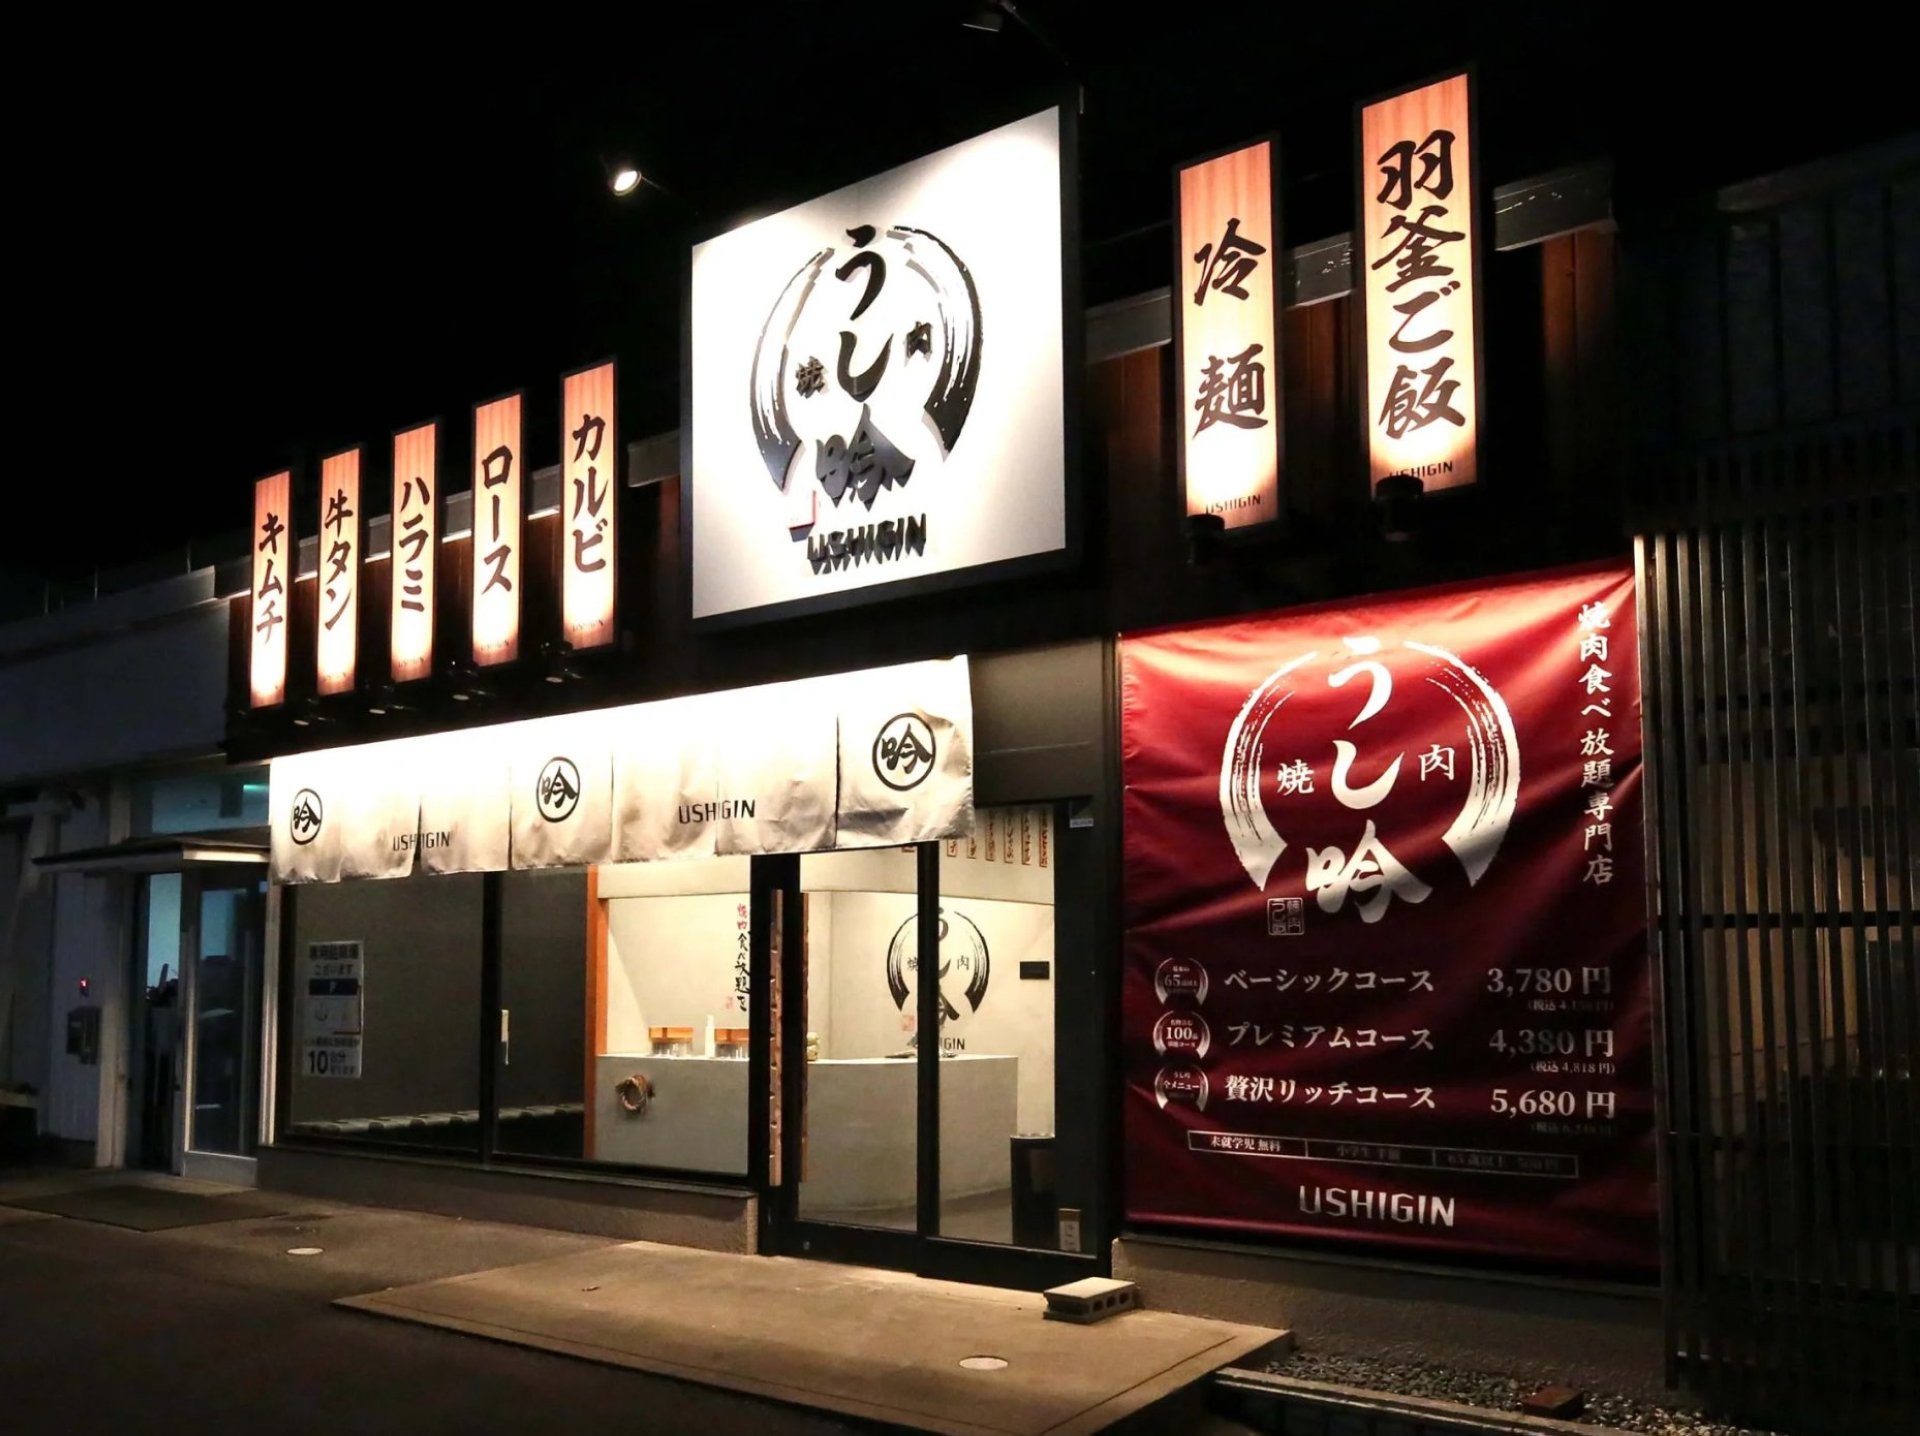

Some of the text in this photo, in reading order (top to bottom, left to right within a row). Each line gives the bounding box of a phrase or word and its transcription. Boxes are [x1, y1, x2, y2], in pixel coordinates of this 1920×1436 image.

[1193, 217, 1269, 440] 冷麺
[1371, 129, 1466, 440] 羽釜ご飯
[324, 488, 354, 631] 牛タン
[398, 476, 431, 613] ハラミ
[480, 445, 514, 596] ロース
[572, 414, 609, 573] カルビ
[807, 512, 928, 575] USHIGIN
[255, 512, 285, 645] キムチ
[1577, 601, 1615, 886] 焼肉食べ放題専門店
[392, 830, 451, 852] USHIGIN
[678, 799, 757, 825] USHIGIN
[1224, 967, 1436, 993] ベーシックコース
[1227, 1022, 1436, 1052] プレミアムコース
[1224, 1075, 1437, 1110] 贅沢リッチコース
[1298, 1184, 1456, 1229] USHIGIN
